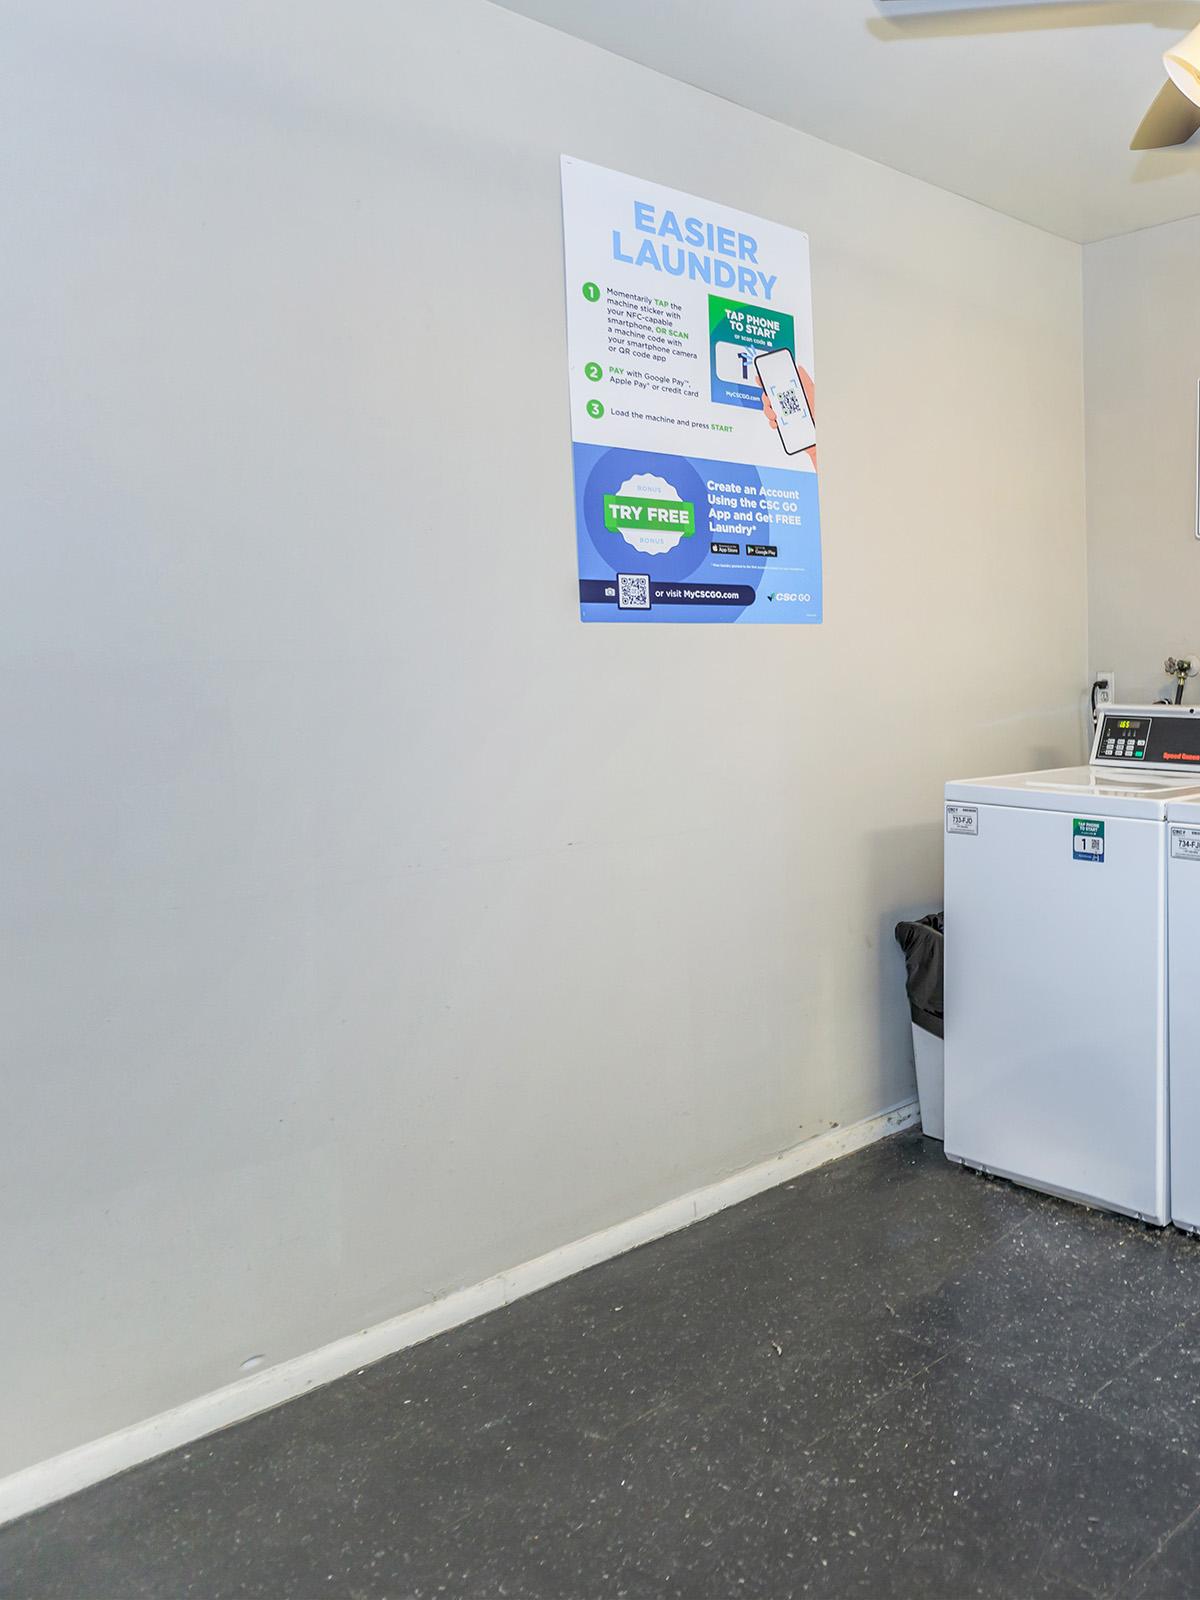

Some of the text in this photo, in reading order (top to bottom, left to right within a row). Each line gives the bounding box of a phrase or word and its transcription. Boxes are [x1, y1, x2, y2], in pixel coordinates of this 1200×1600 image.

[634, 200, 759, 264] EASIER
[612, 230, 778, 300] LAUNDRY
[607, 287, 682, 311] Momentarily TAP the
[607, 298, 681, 320] machine sticker with
[627, 311, 673, 328] NFC-capable
[725, 308, 781, 332] TAP PHONE
[615, 328, 646, 340] machine
[647, 334, 666, 344] code
[667, 339, 682, 348] with
[656, 326, 668, 335] OR
[669, 329, 689, 340] SCAN
[730, 320, 777, 340] TO START
[608, 336, 698, 360] your smartphone camera
[608, 345, 667, 363] or QR code app
[609, 366, 625, 376] PAY
[627, 369, 643, 379] with
[645, 373, 672, 386] Google
[609, 376, 632, 388] Apple
[652, 384, 660, 392] or
[662, 384, 683, 395] credit
[684, 389, 700, 398] card
[611, 408, 734, 433] Load the machine and press START
[707, 480, 801, 500] Create an Account
[708, 493, 798, 513] Using the CSC GO
[608, 503, 690, 525] TRY FREE
[709, 508, 802, 526] App and Get FREE
[655, 589, 740, 601] or visit MyCSCGO.com
[775, 592, 812, 602] CSC GO
